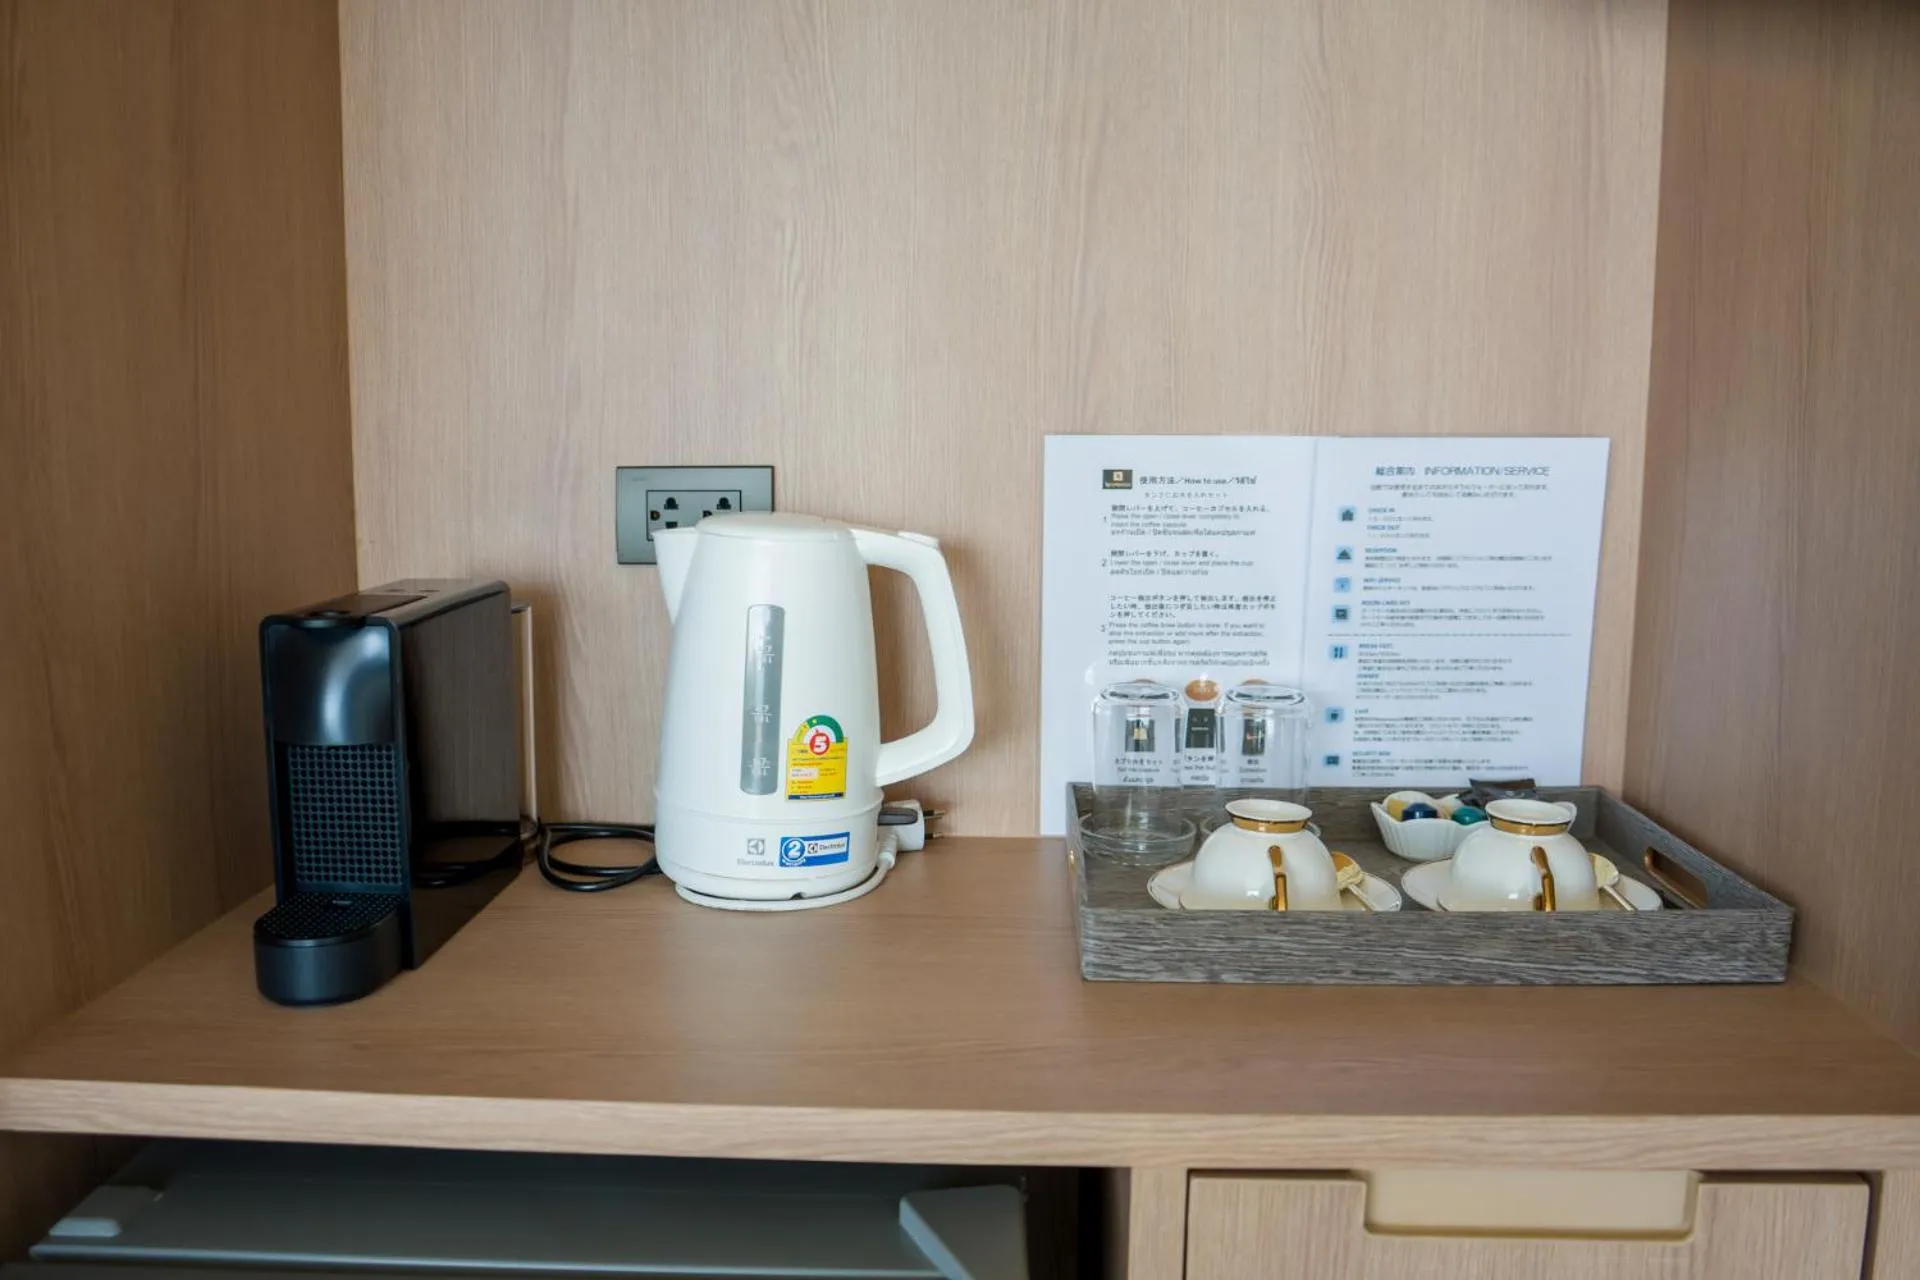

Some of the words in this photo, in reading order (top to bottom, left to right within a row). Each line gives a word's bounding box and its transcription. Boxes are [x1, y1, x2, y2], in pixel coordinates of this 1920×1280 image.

[1203, 477, 1211, 485] to
[813, 734, 829, 752] 5
[787, 840, 801, 859] 2
